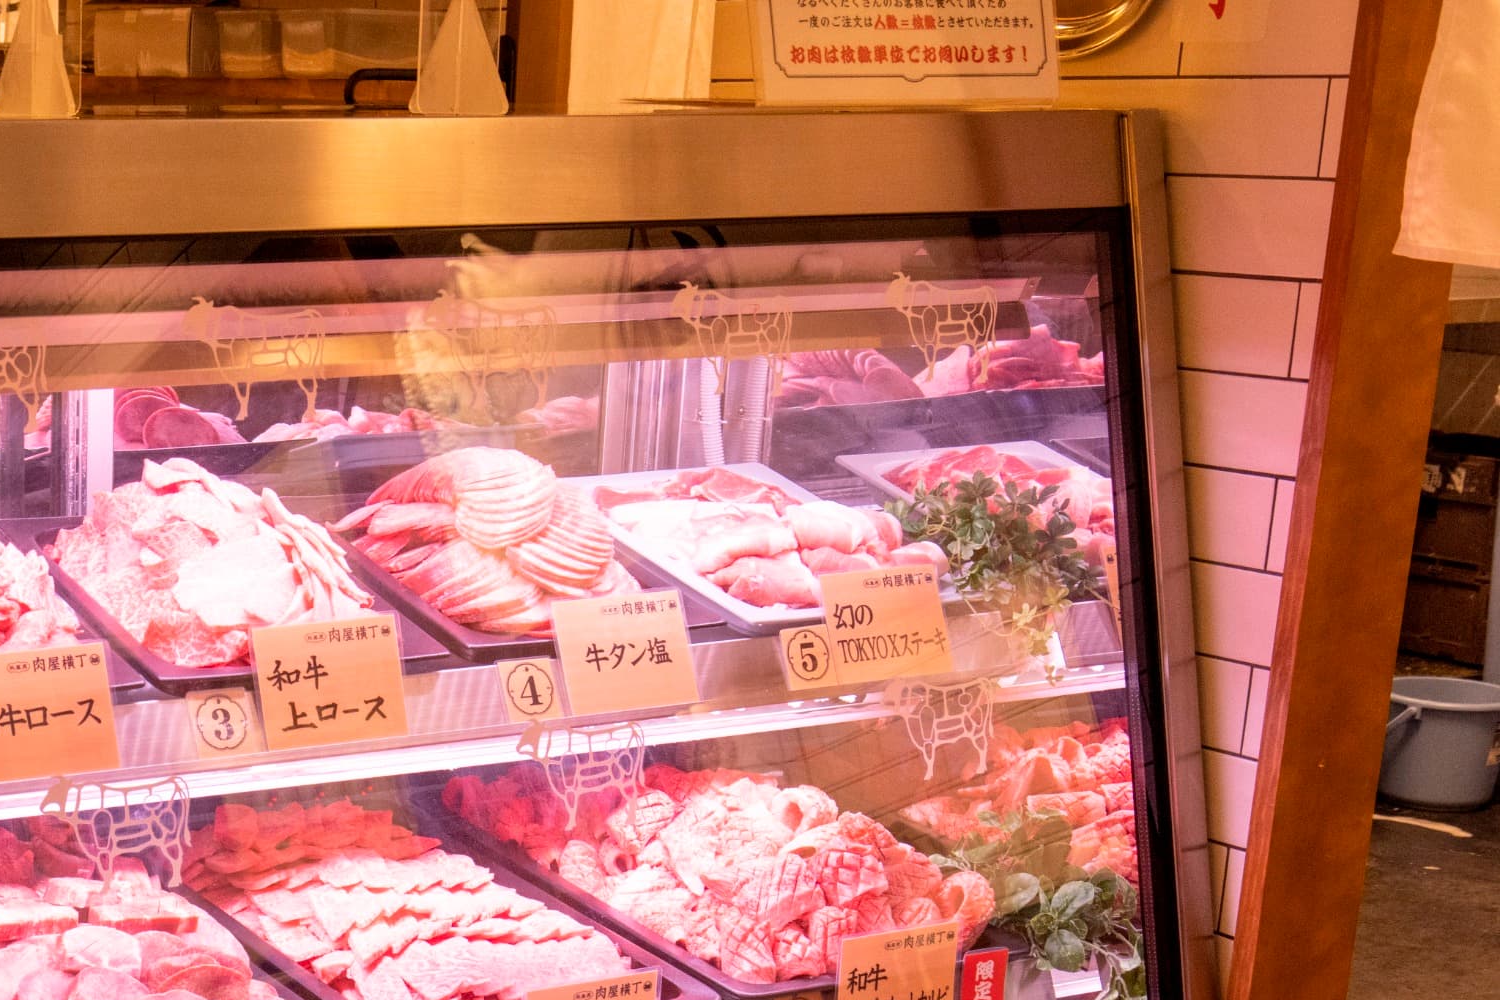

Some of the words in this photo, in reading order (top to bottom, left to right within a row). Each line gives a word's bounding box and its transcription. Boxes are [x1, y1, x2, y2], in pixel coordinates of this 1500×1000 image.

[833, 603, 874, 630] 幻の
[328, 625, 379, 644] 肉屋横丁
[32, 653, 88, 673] 肉屋横丁
[585, 637, 673, 673] 牛タン塩
[800, 642, 819, 673] 5
[266, 655, 329, 692] 和牛
[520, 675, 543, 706] 4
[211, 708, 233, 741] 3
[281, 695, 388, 732] 上ロース
[595, 981, 643, 1000] 肉屋横丁
[846, 963, 889, 995] 和牛
